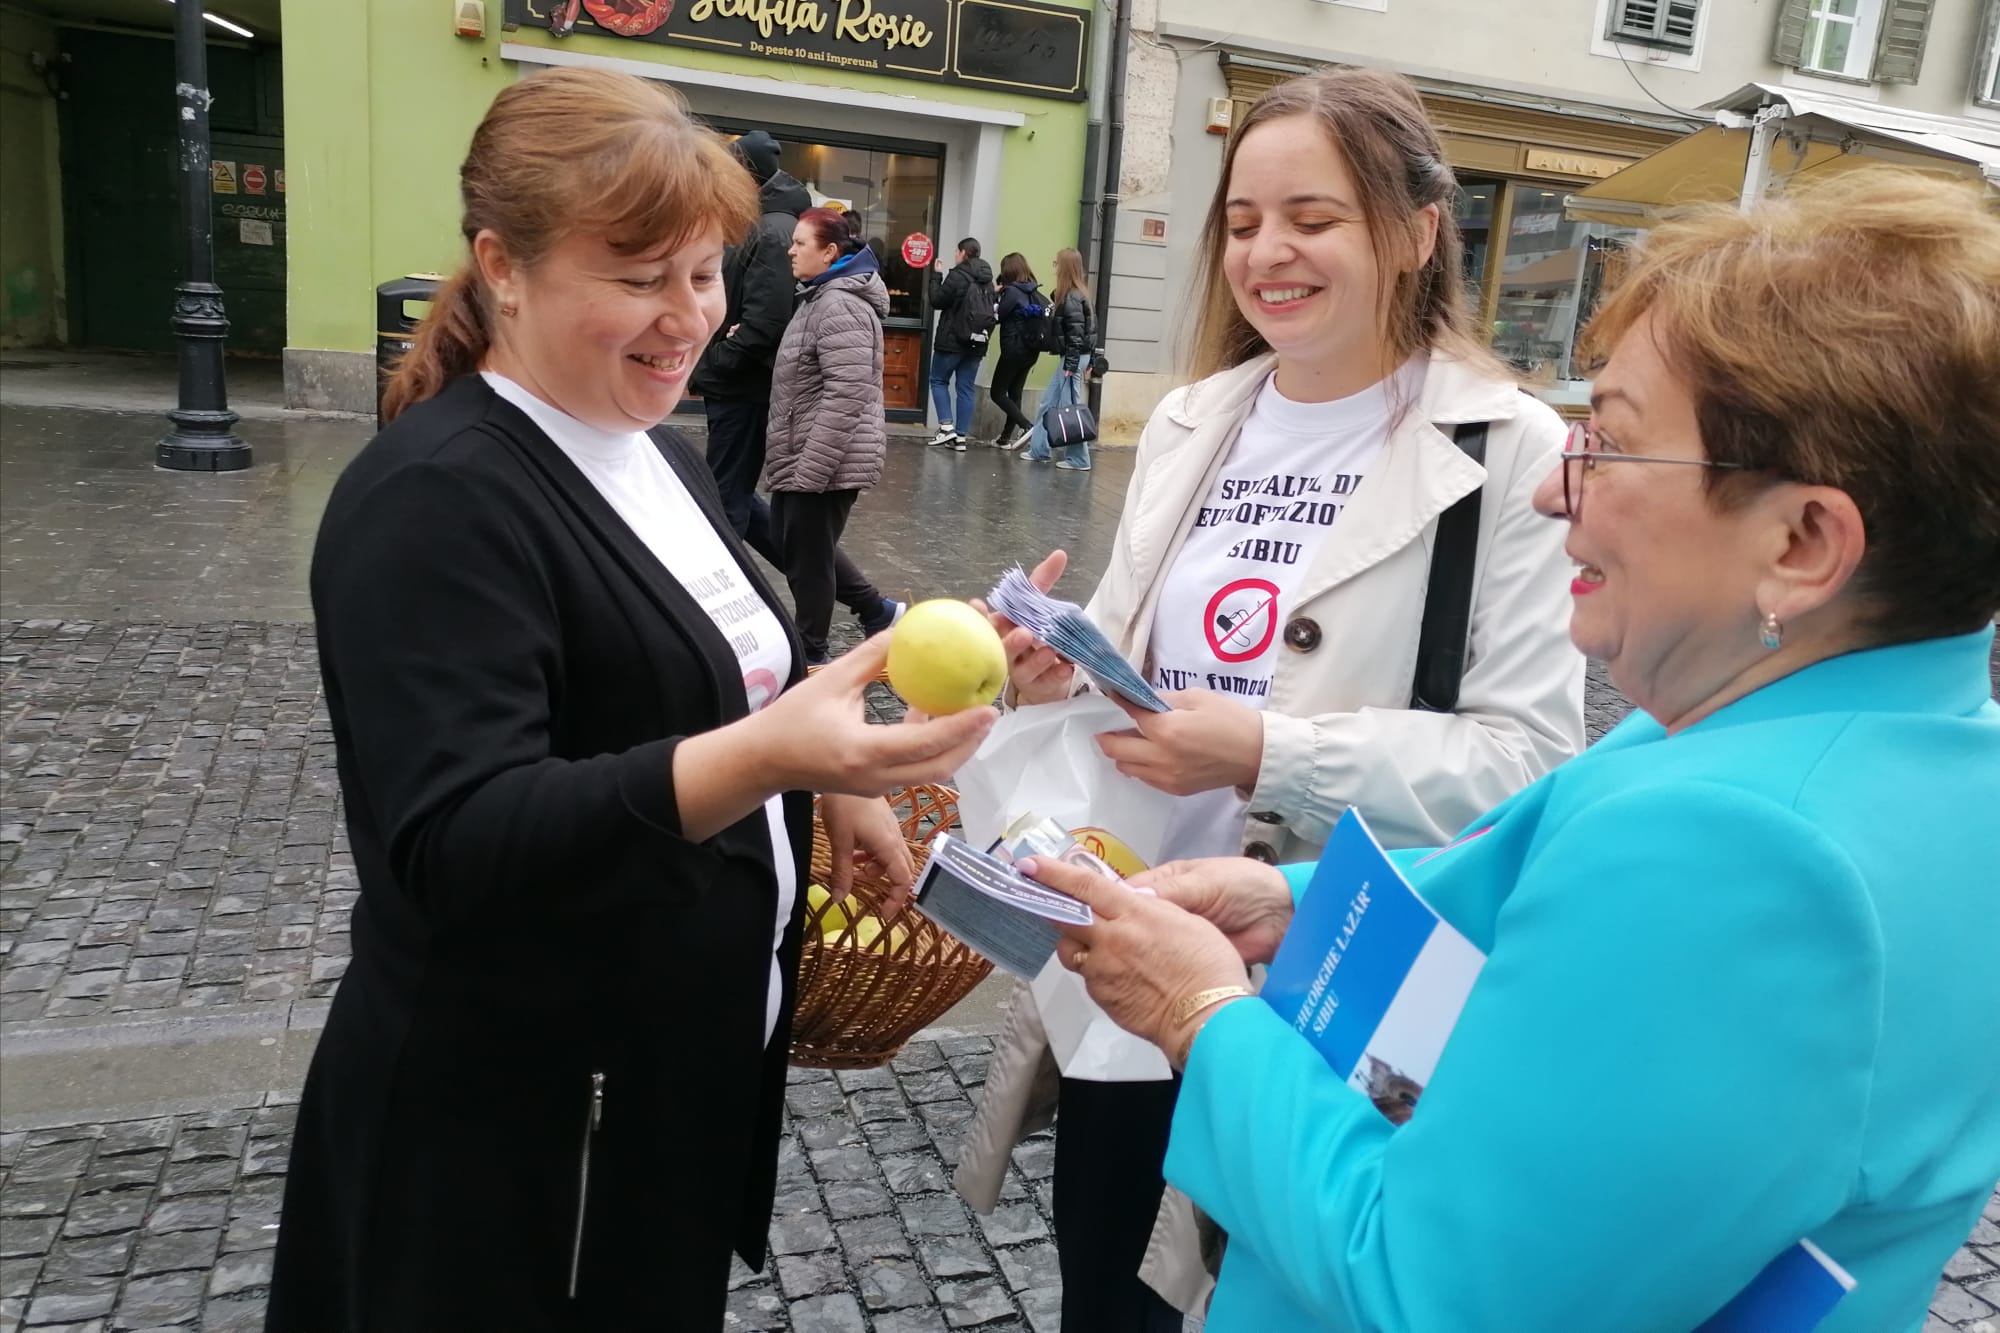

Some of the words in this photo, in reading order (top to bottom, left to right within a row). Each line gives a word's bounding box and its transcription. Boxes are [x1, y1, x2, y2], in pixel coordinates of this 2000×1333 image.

[750, 41, 764, 52] De
[765, 45, 794, 56] peste
[795, 48, 807, 58] 10
[807, 51, 825, 61] ani
[826, 52, 879, 69] împreună
[1534, 157, 1599, 175] ANNA
[1227, 539, 1302, 565] SIBIU
[712, 567, 736, 591] DE
[730, 630, 760, 659] IBIU
[1312, 989, 1340, 1038] SIBIU
